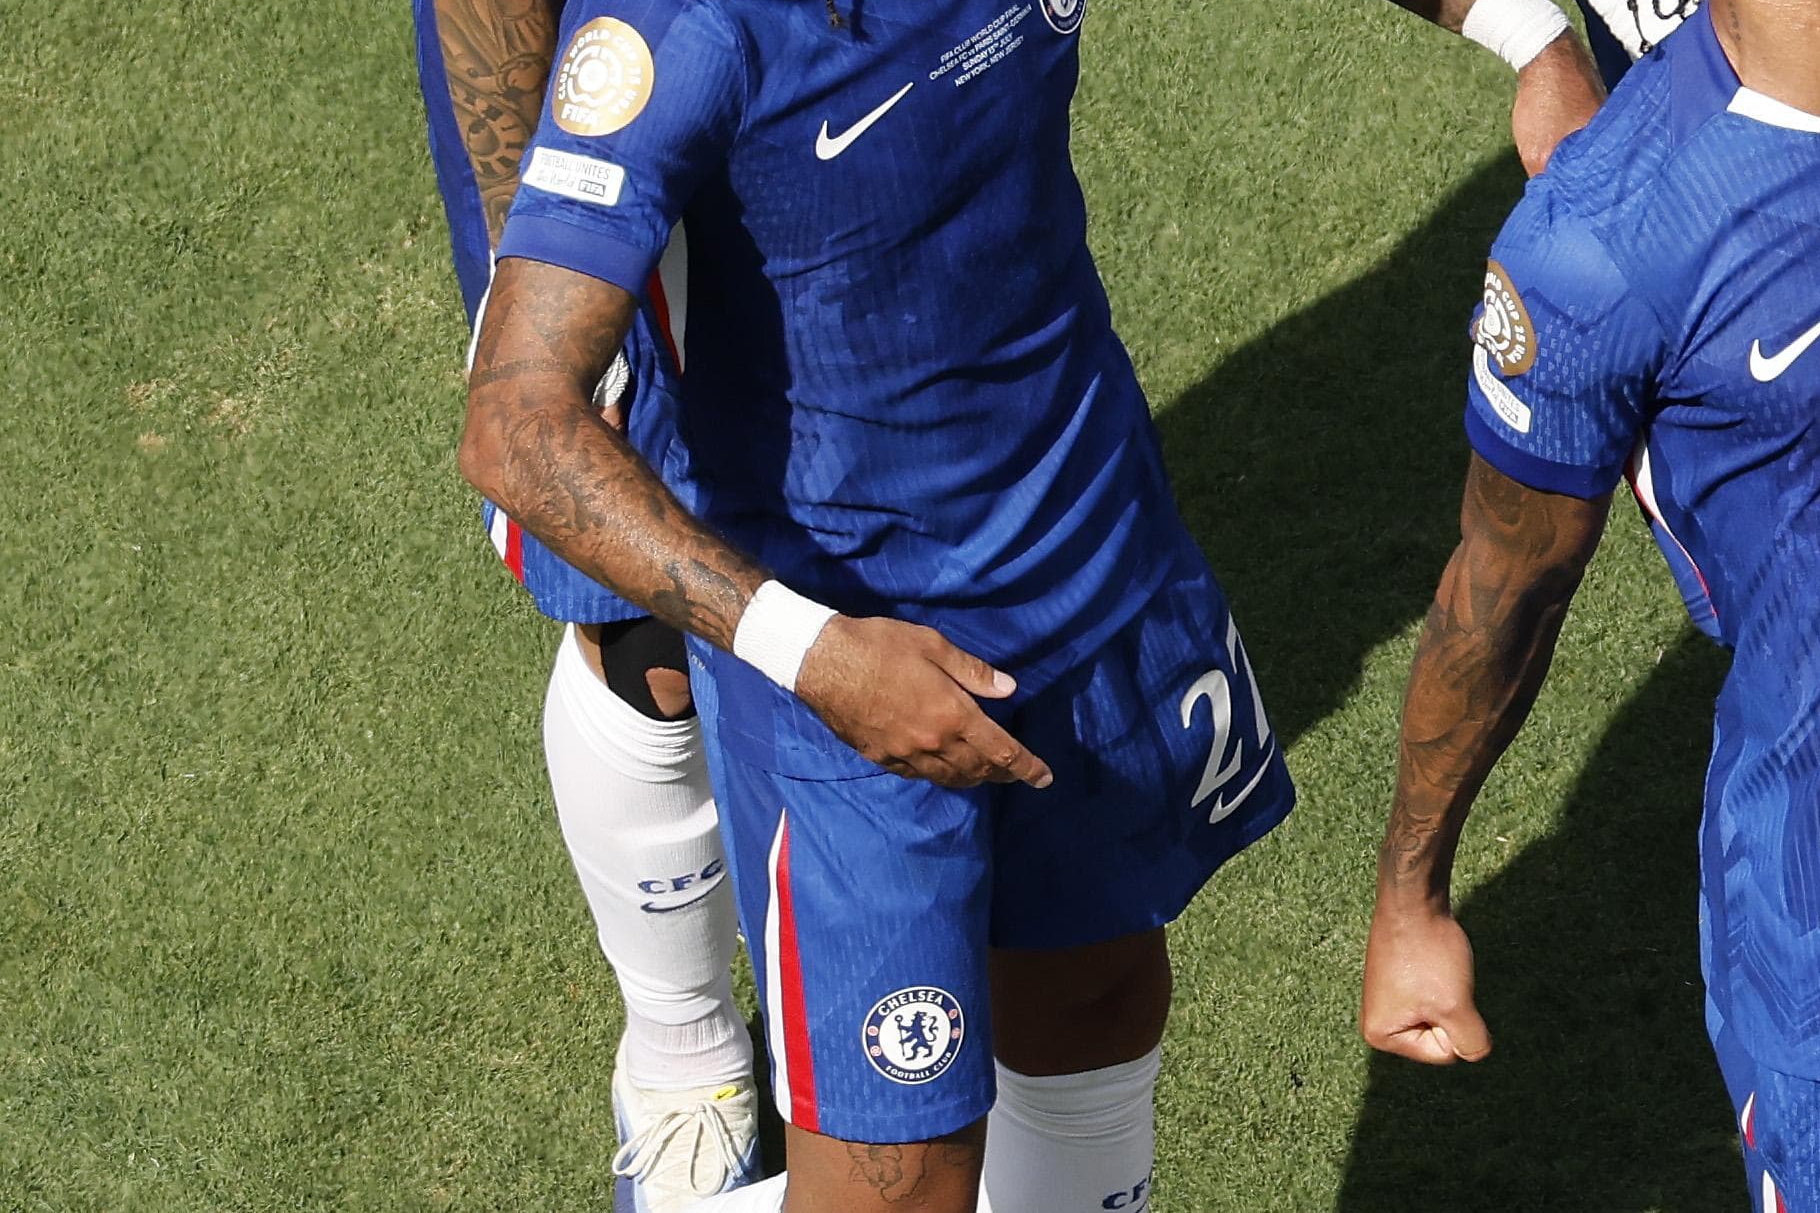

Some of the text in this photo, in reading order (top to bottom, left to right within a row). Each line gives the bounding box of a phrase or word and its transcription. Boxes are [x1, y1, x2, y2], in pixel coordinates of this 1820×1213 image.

[570, 30, 610, 58] WORLD
[941, 50, 954, 64] FIFA
[954, 39, 971, 54] CLUB
[970, 24, 993, 43] WORLD
[992, 14, 1005, 28] CUP
[930, 58, 958, 80] CHELSEA
[975, 36, 994, 52] PARIS
[954, 72, 971, 86] NEW
[990, 50, 1005, 64] NEW
[962, 50, 988, 70] SUNDAY
[576, 162, 610, 180] UNITES
[1502, 291, 1520, 320] CUP
[1514, 324, 1526, 342] 25
[1506, 344, 1526, 364] USA
[637, 858, 724, 894] CFC
[878, 990, 944, 1016] CHELSEA
[885, 1052, 952, 1080] FOOTBALL CLUB
[1101, 1165, 1153, 1210] CF
